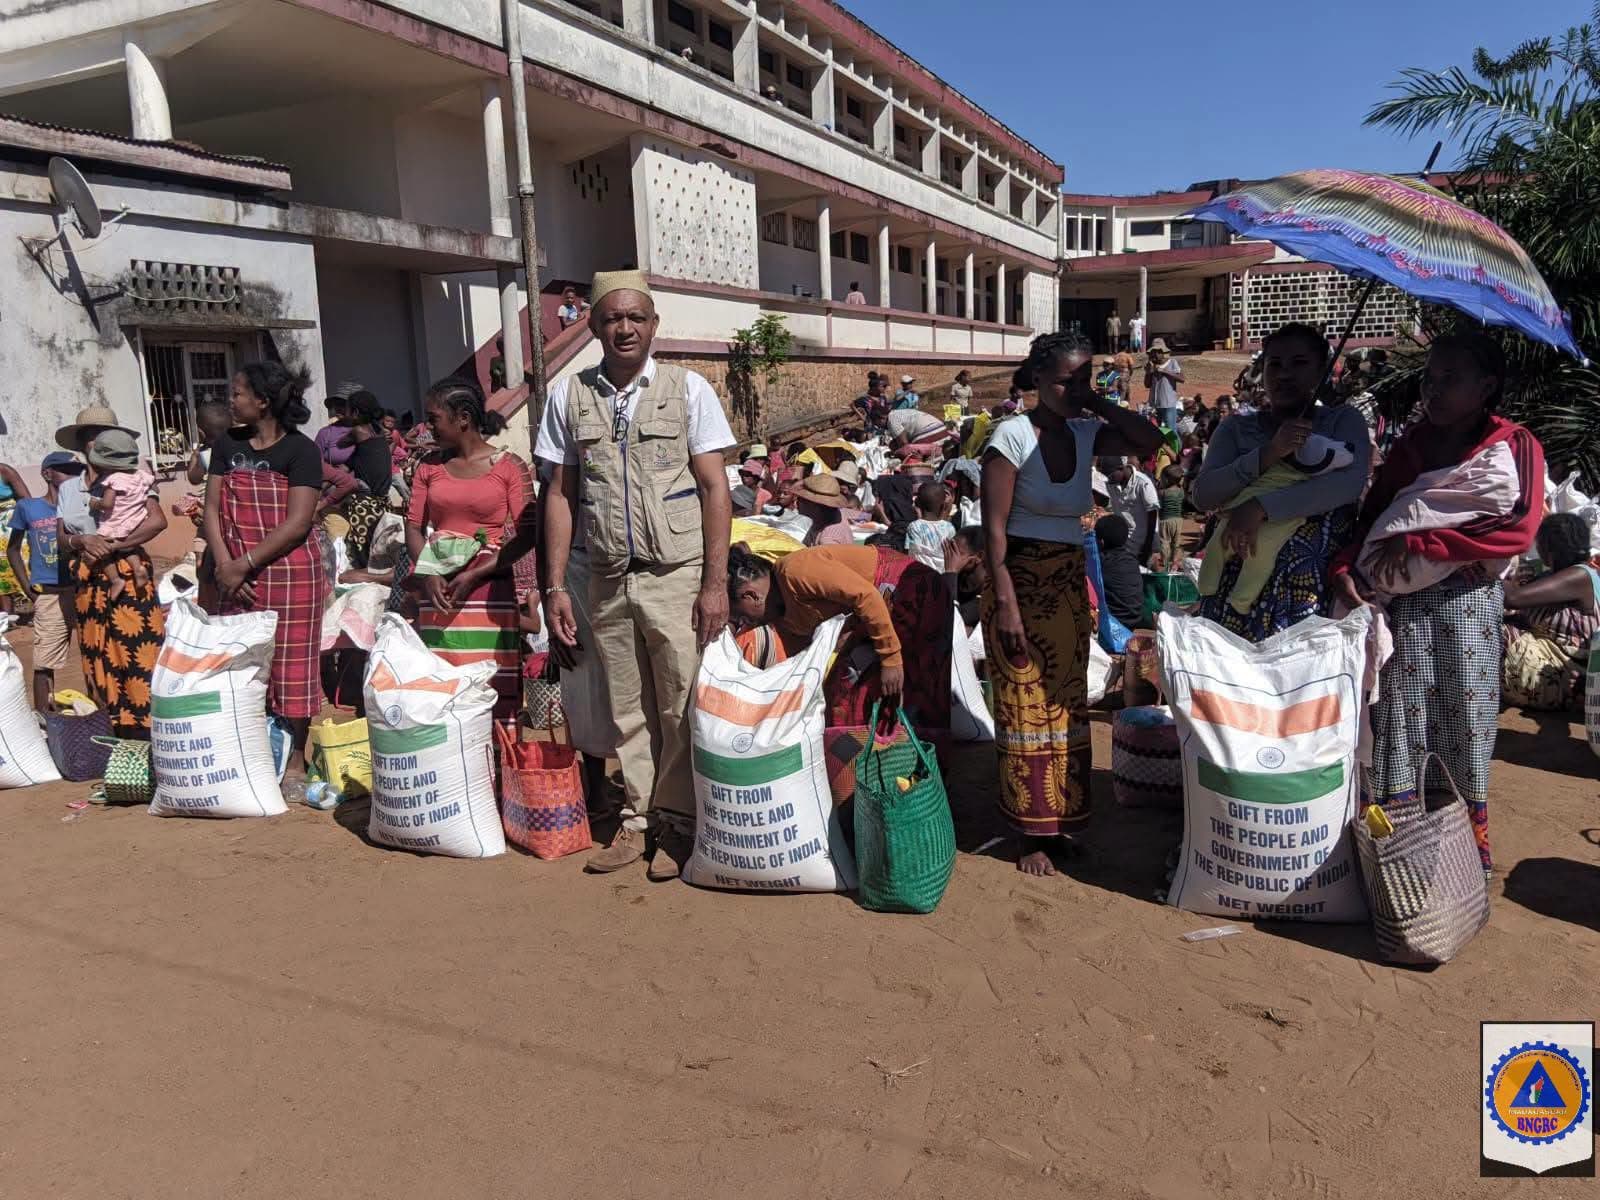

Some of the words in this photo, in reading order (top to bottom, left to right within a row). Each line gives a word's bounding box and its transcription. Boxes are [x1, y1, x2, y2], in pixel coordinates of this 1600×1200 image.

[164, 721, 193, 735] FROM
[157, 739, 186, 752] PEOPLE
[189, 737, 212, 752] AND
[201, 753, 216, 768] OF
[389, 755, 418, 771] FROM
[191, 773, 204, 787] OF
[206, 767, 240, 785] INDIA
[378, 775, 410, 791] PEOPLE
[413, 770, 437, 789] AND
[175, 794, 220, 808] WEIGHT
[425, 789, 440, 805] OF
[711, 784, 732, 803] GIFT
[736, 785, 773, 805] FROM
[412, 813, 425, 827] OF
[429, 801, 461, 824] INDIA
[720, 808, 766, 827] PEOPLE
[768, 802, 795, 820] AND
[1228, 801, 1260, 823] GIFT
[1264, 806, 1309, 826] FROM
[397, 834, 441, 847] WEIGHT
[705, 822, 779, 849] GOVERNMENT
[783, 824, 799, 843] OF
[1210, 816, 1234, 841] THE
[1238, 827, 1297, 850] PEOPLE
[1301, 823, 1329, 847] AND
[711, 846, 767, 870] REPUBLIC
[769, 852, 785, 868] OF
[788, 837, 822, 864] INDIA
[1211, 839, 1310, 871] GOVERNMENT
[1314, 846, 1329, 866] OF
[1193, 849, 1213, 876] THE
[1216, 864, 1290, 892] REPUBLIC
[1294, 875, 1313, 893] OF
[1317, 859, 1351, 889] INDIA
[744, 875, 801, 889] WEIGHT
[1217, 893, 1251, 911] NET
[1255, 900, 1327, 914] WEIGHT
